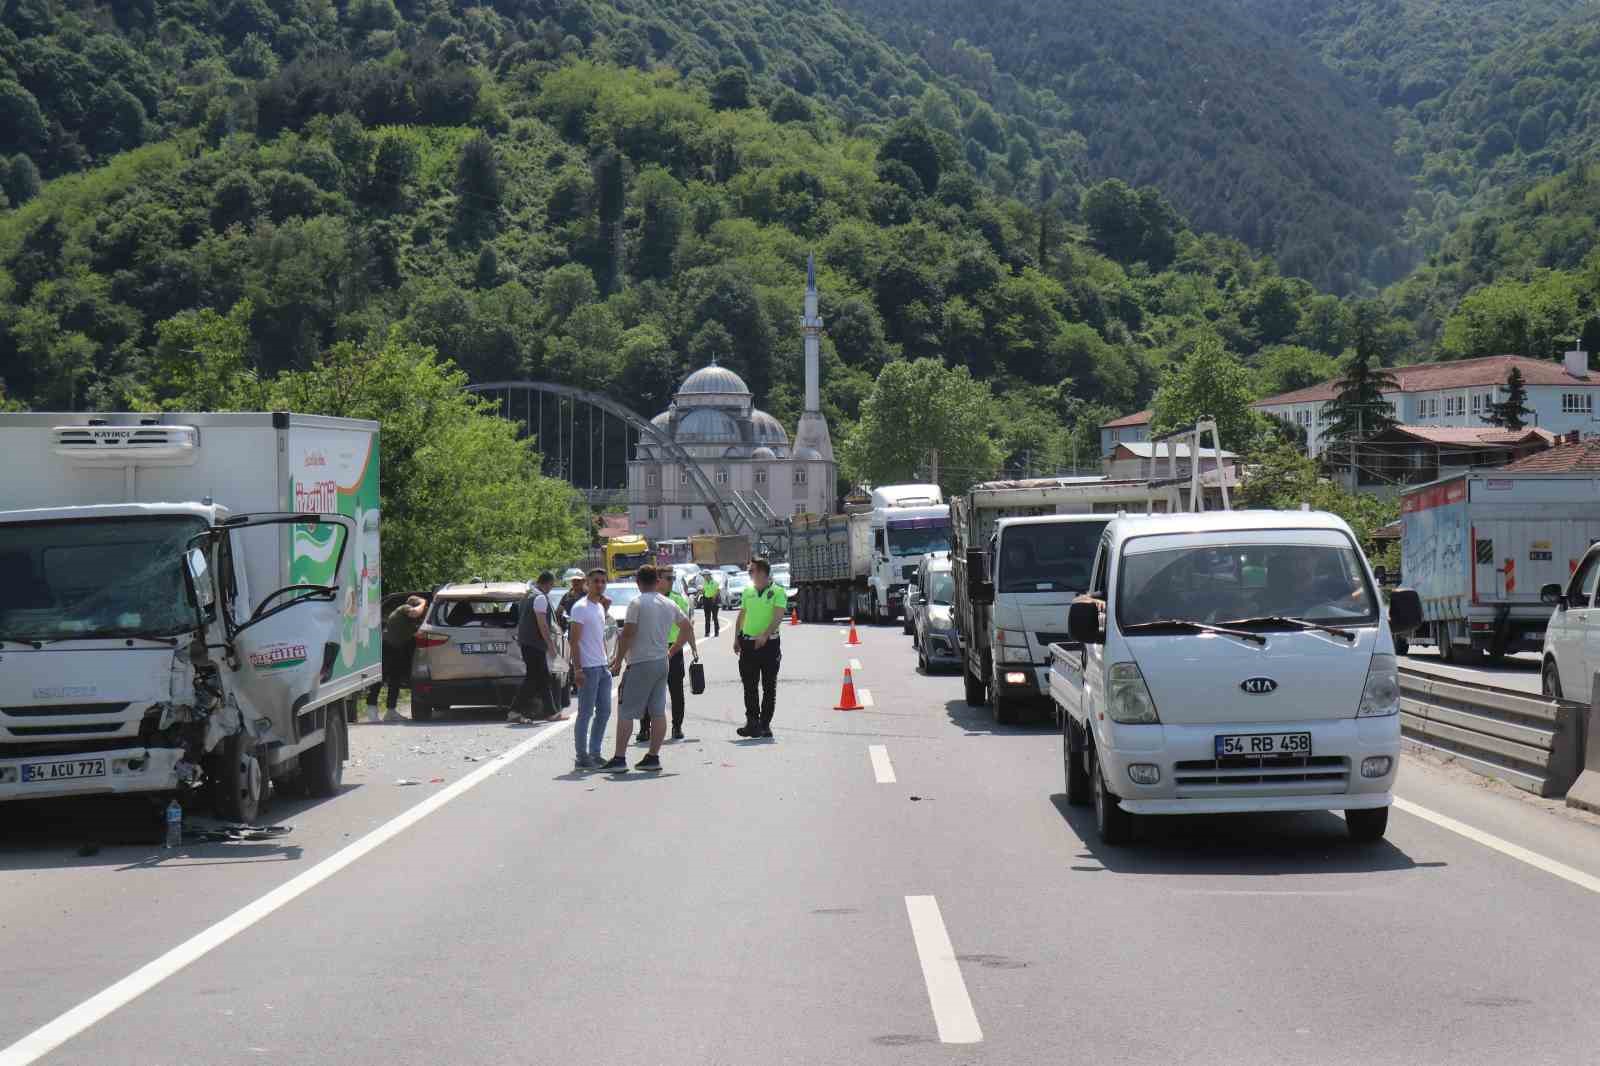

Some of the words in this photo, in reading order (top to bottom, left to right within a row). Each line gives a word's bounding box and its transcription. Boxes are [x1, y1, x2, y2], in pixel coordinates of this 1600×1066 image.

[1246, 680, 1272, 692] KIA
[1224, 737, 1243, 752] 54
[1251, 736, 1274, 751] RB
[1280, 735, 1308, 750] 458
[29, 767, 44, 779] 54
[79, 761, 104, 774] 772
